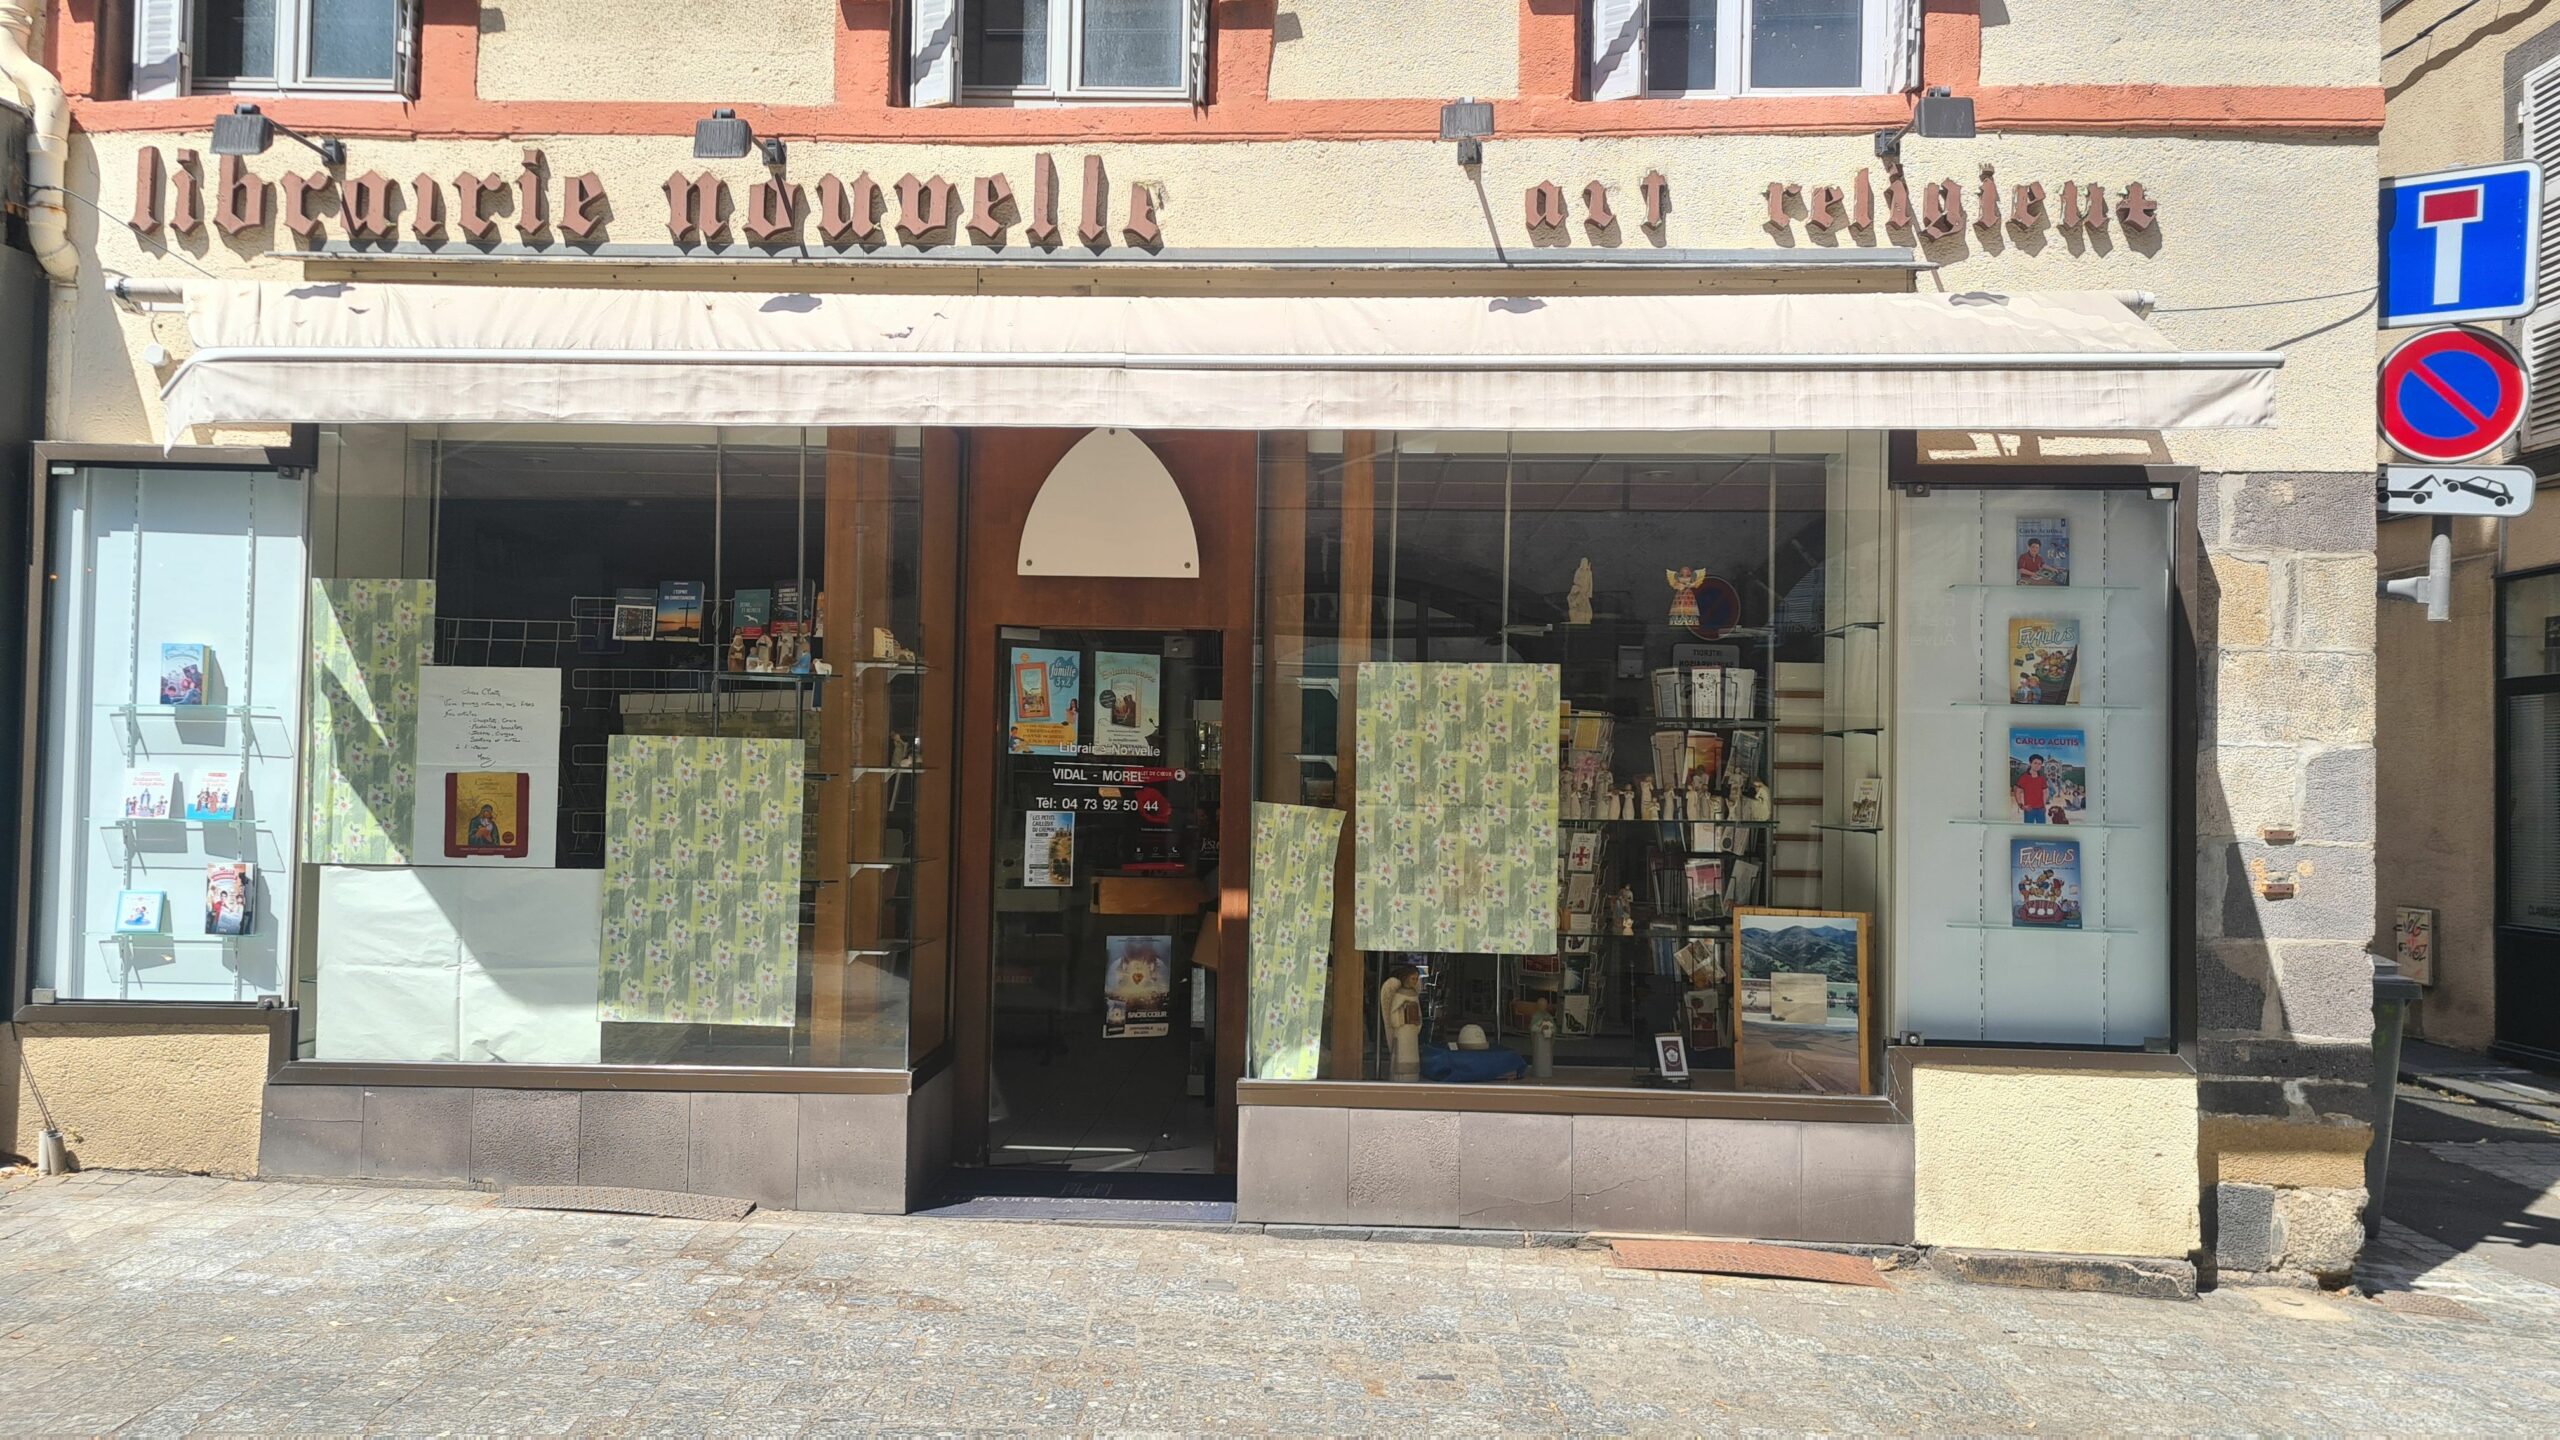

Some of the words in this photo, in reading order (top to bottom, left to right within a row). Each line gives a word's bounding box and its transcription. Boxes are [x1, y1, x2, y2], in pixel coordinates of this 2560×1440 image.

[128, 146, 605, 238] librairie
[1525, 169, 1669, 231] art
[1059, 741, 1107, 755] Librairie
[1111, 743, 1161, 757] Nouvelle
[2015, 737, 2045, 746] CARLO
[2048, 738, 2080, 748] ACUTIS
[1052, 768, 1088, 781] VIDAL
[1102, 770, 1145, 783] MOREL
[1036, 796, 1058, 809] Tél:
[1062, 798, 1079, 810] 04
[1083, 798, 1098, 810] 73
[1103, 799, 1118, 811] 92
[1123, 799, 1138, 811] 50
[1143, 800, 1159, 812] 44
[2018, 846, 2075, 872] FAMILIUS
